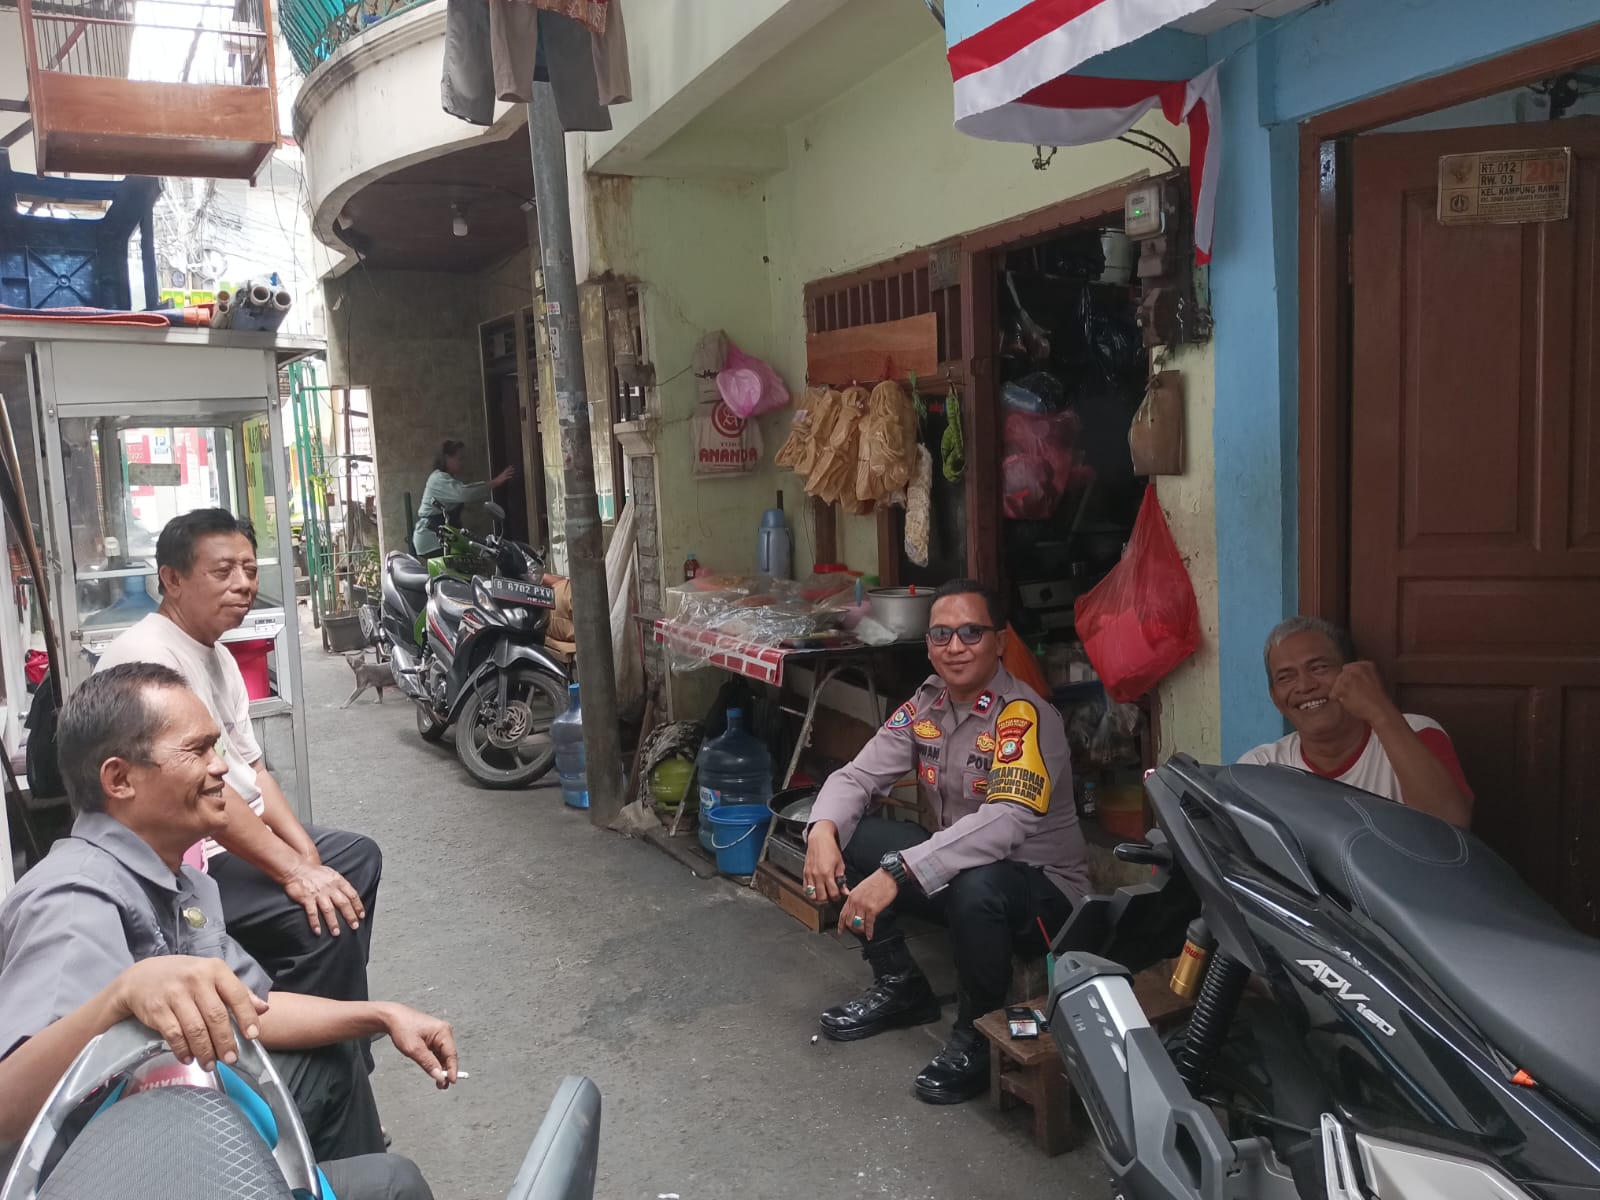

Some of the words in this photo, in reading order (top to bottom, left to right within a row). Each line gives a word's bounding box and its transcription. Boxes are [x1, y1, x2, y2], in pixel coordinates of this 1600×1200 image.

[1481, 163, 1494, 174] RT.
[1497, 162, 1516, 173] 012
[1526, 161, 1553, 182] 20
[1480, 175, 1497, 186] RW.
[1500, 174, 1513, 185] 03
[1499, 185, 1535, 196] KAMPUNG
[1538, 183, 1560, 193] RAWA
[699, 448, 758, 463] ANANDA
[497, 580, 503, 590] B
[507, 582, 530, 593] 6702
